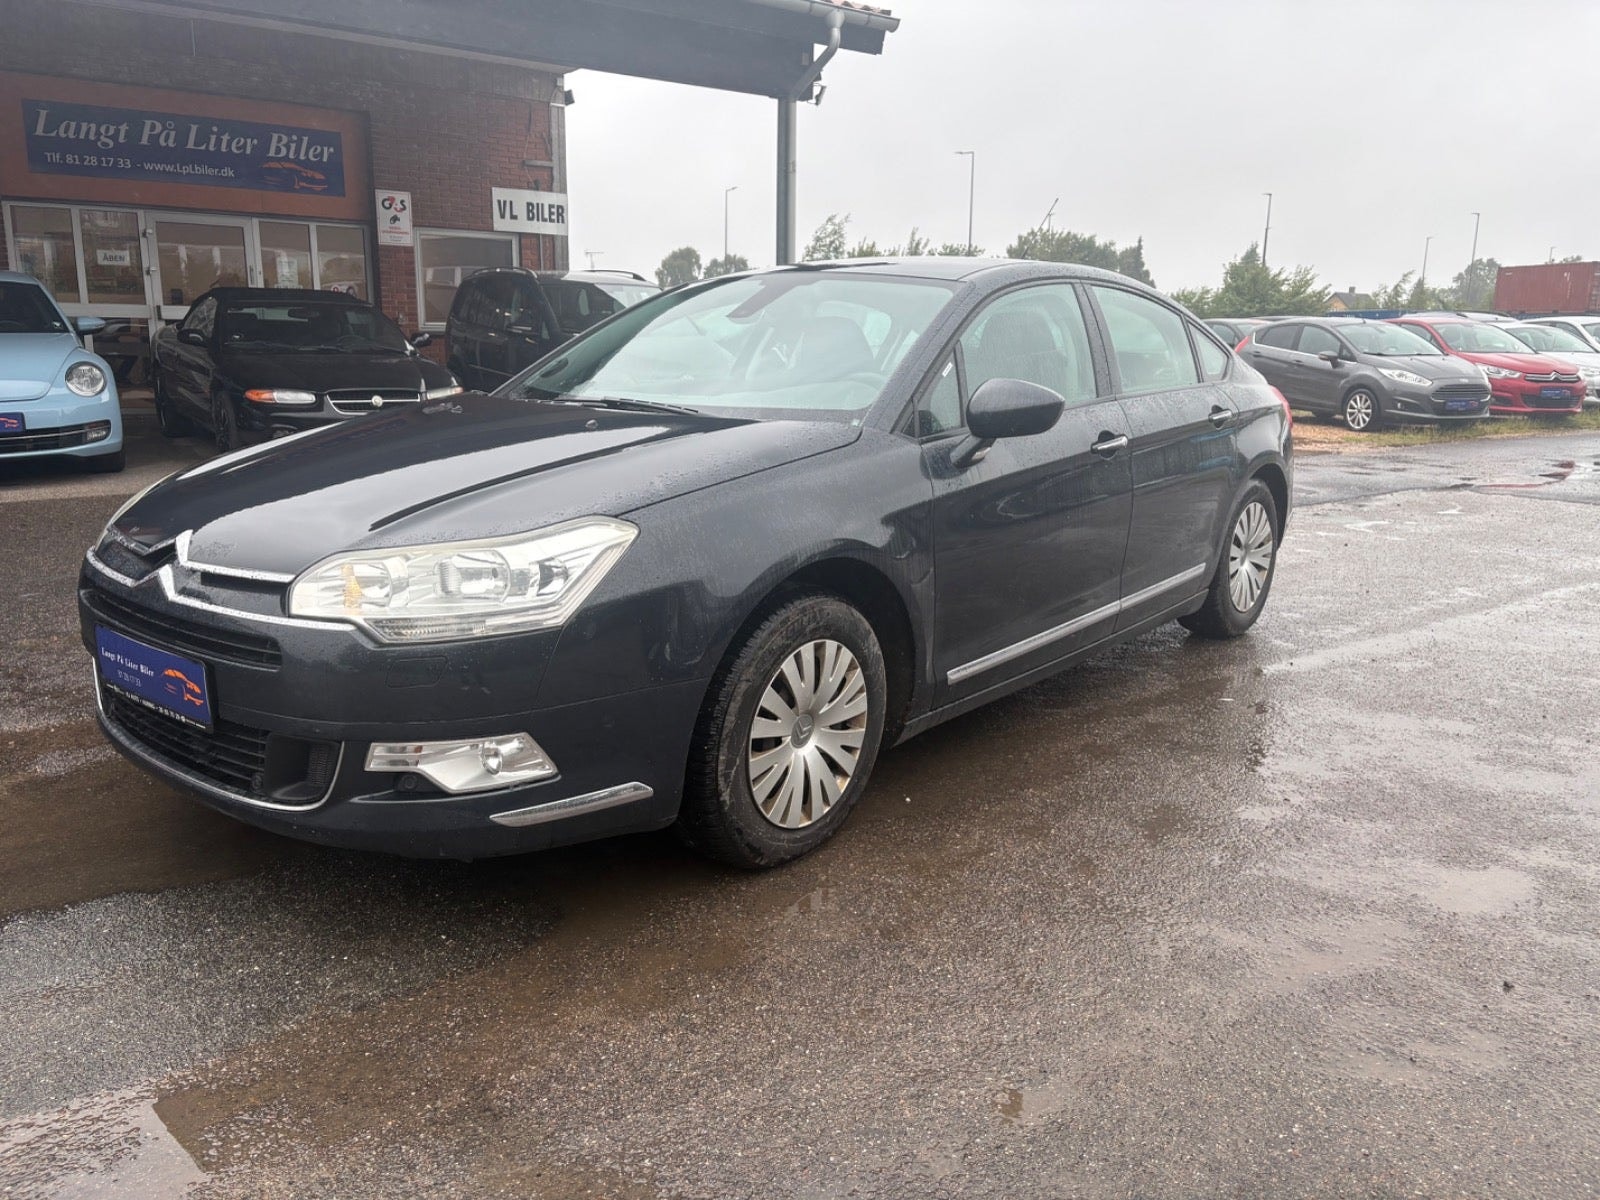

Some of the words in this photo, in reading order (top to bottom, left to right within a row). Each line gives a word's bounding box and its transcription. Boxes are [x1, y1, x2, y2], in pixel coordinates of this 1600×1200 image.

[34, 108, 129, 149] Langt
[138, 119, 177, 148] På
[184, 123, 258, 155] Liter
[266, 132, 335, 162] Biler
[44, 152, 63, 164] Tlf.
[66, 154, 80, 165] 81
[84, 155, 98, 166] 28
[101, 157, 114, 168] 17
[117, 157, 132, 169] 33
[143, 161, 235, 178] www.LpLbiler.dk
[497, 199, 518, 220] VL
[526, 201, 565, 224] BILER
